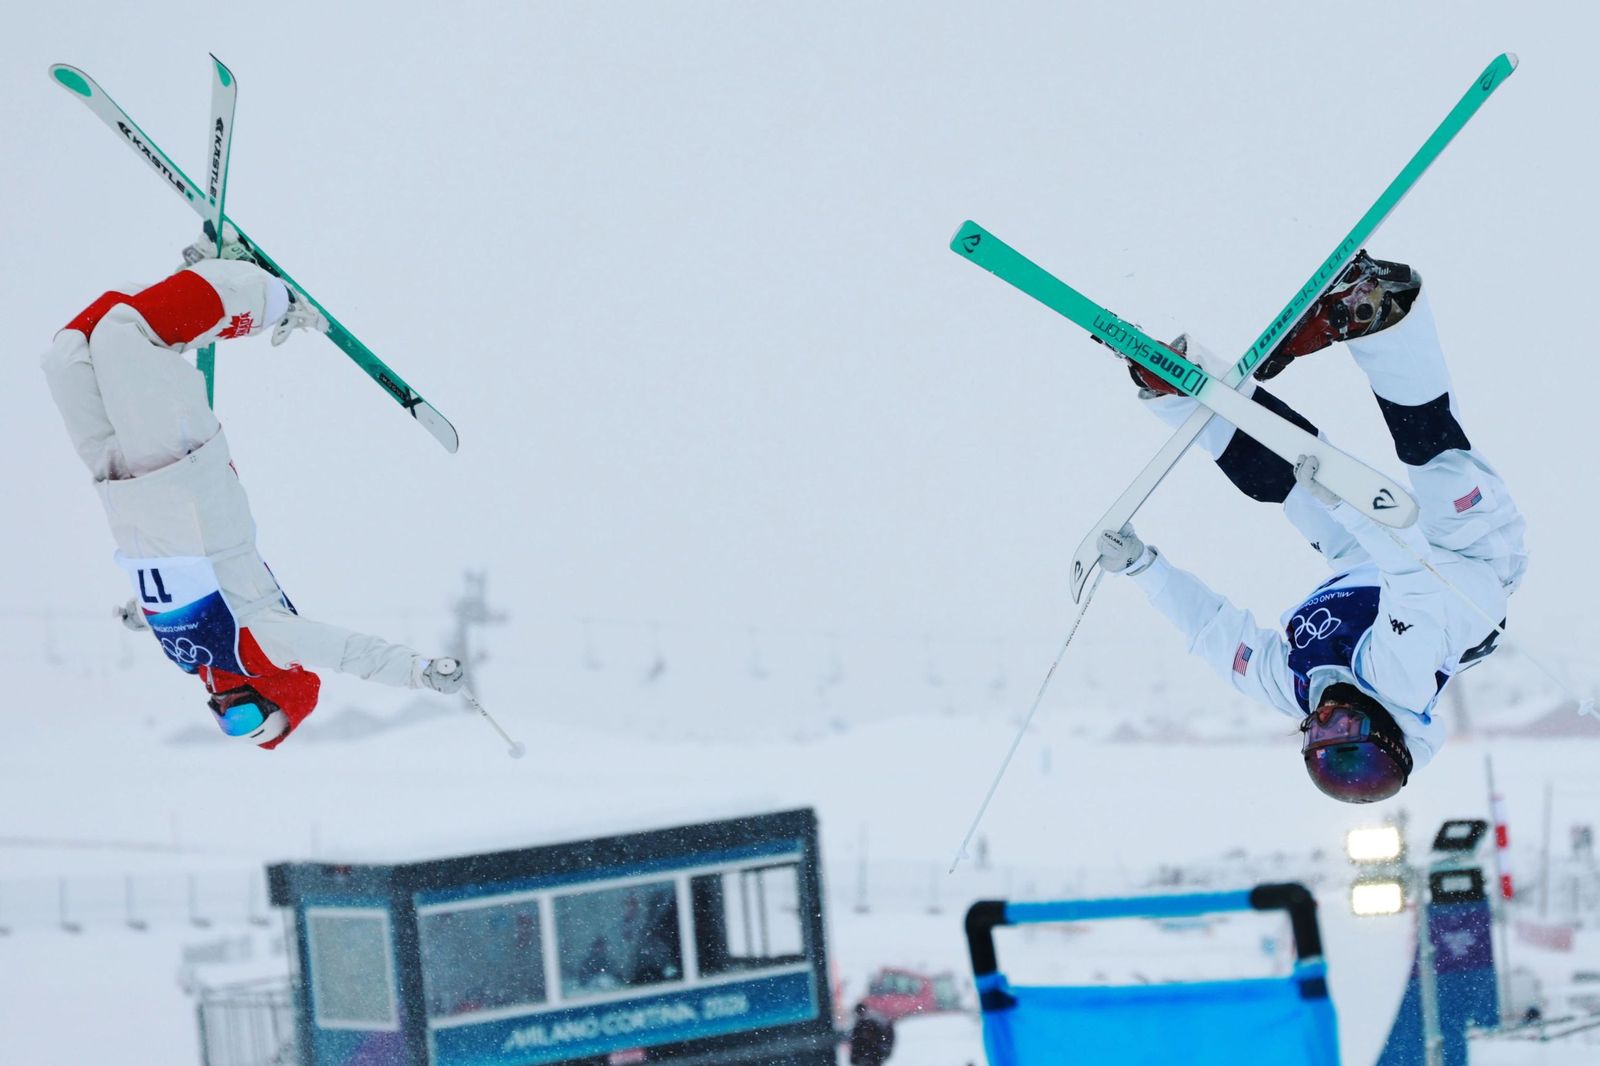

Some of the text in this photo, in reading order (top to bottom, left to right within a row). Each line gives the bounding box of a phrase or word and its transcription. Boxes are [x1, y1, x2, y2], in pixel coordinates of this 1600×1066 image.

[137, 568, 173, 603] 17
[1320, 591, 1355, 603] MILANO
[174, 622, 199, 633] MILANO
[503, 1016, 600, 1050] MILANO
